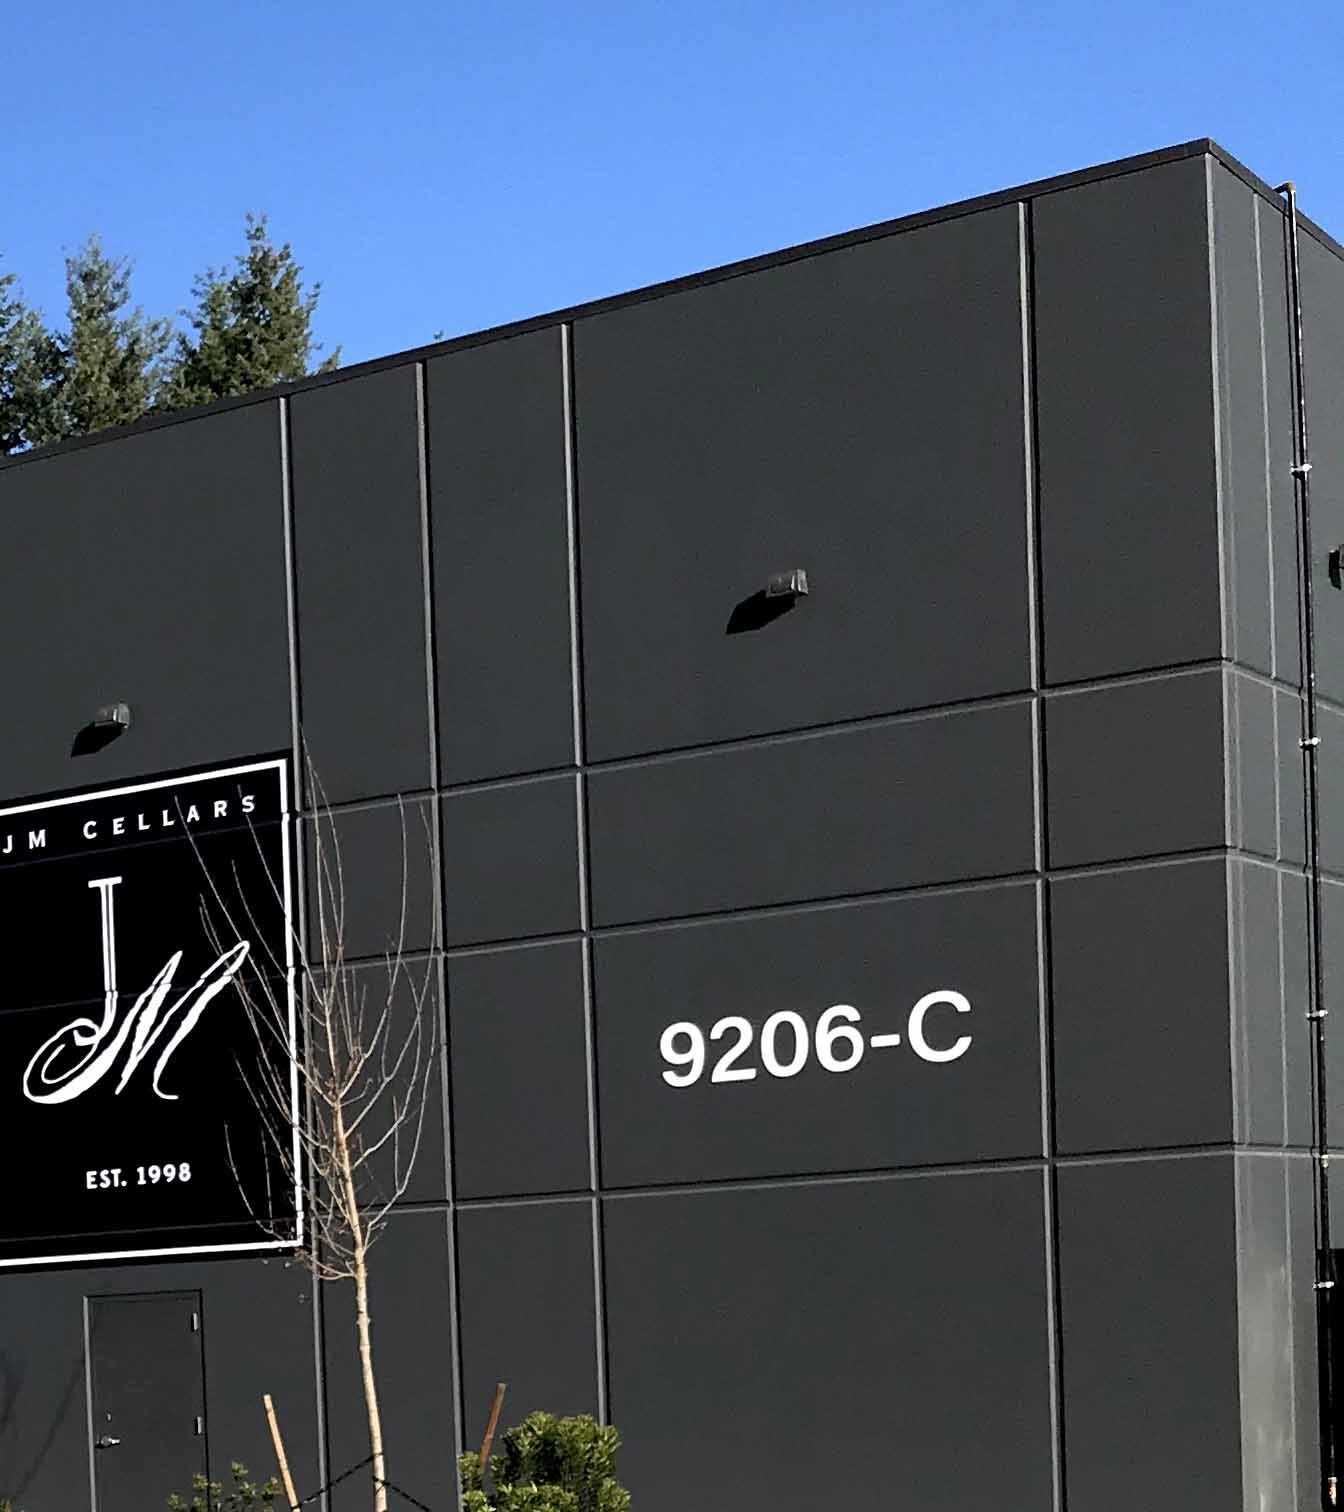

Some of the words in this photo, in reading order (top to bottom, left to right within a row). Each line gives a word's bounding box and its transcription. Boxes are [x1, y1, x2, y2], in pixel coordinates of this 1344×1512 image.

[2, 828, 46, 854] JM
[82, 795, 255, 839] CELLARS
[660, 990, 972, 1087] 9206-C
[86, 1168, 127, 1189] EST.
[136, 1162, 192, 1185] 1998
